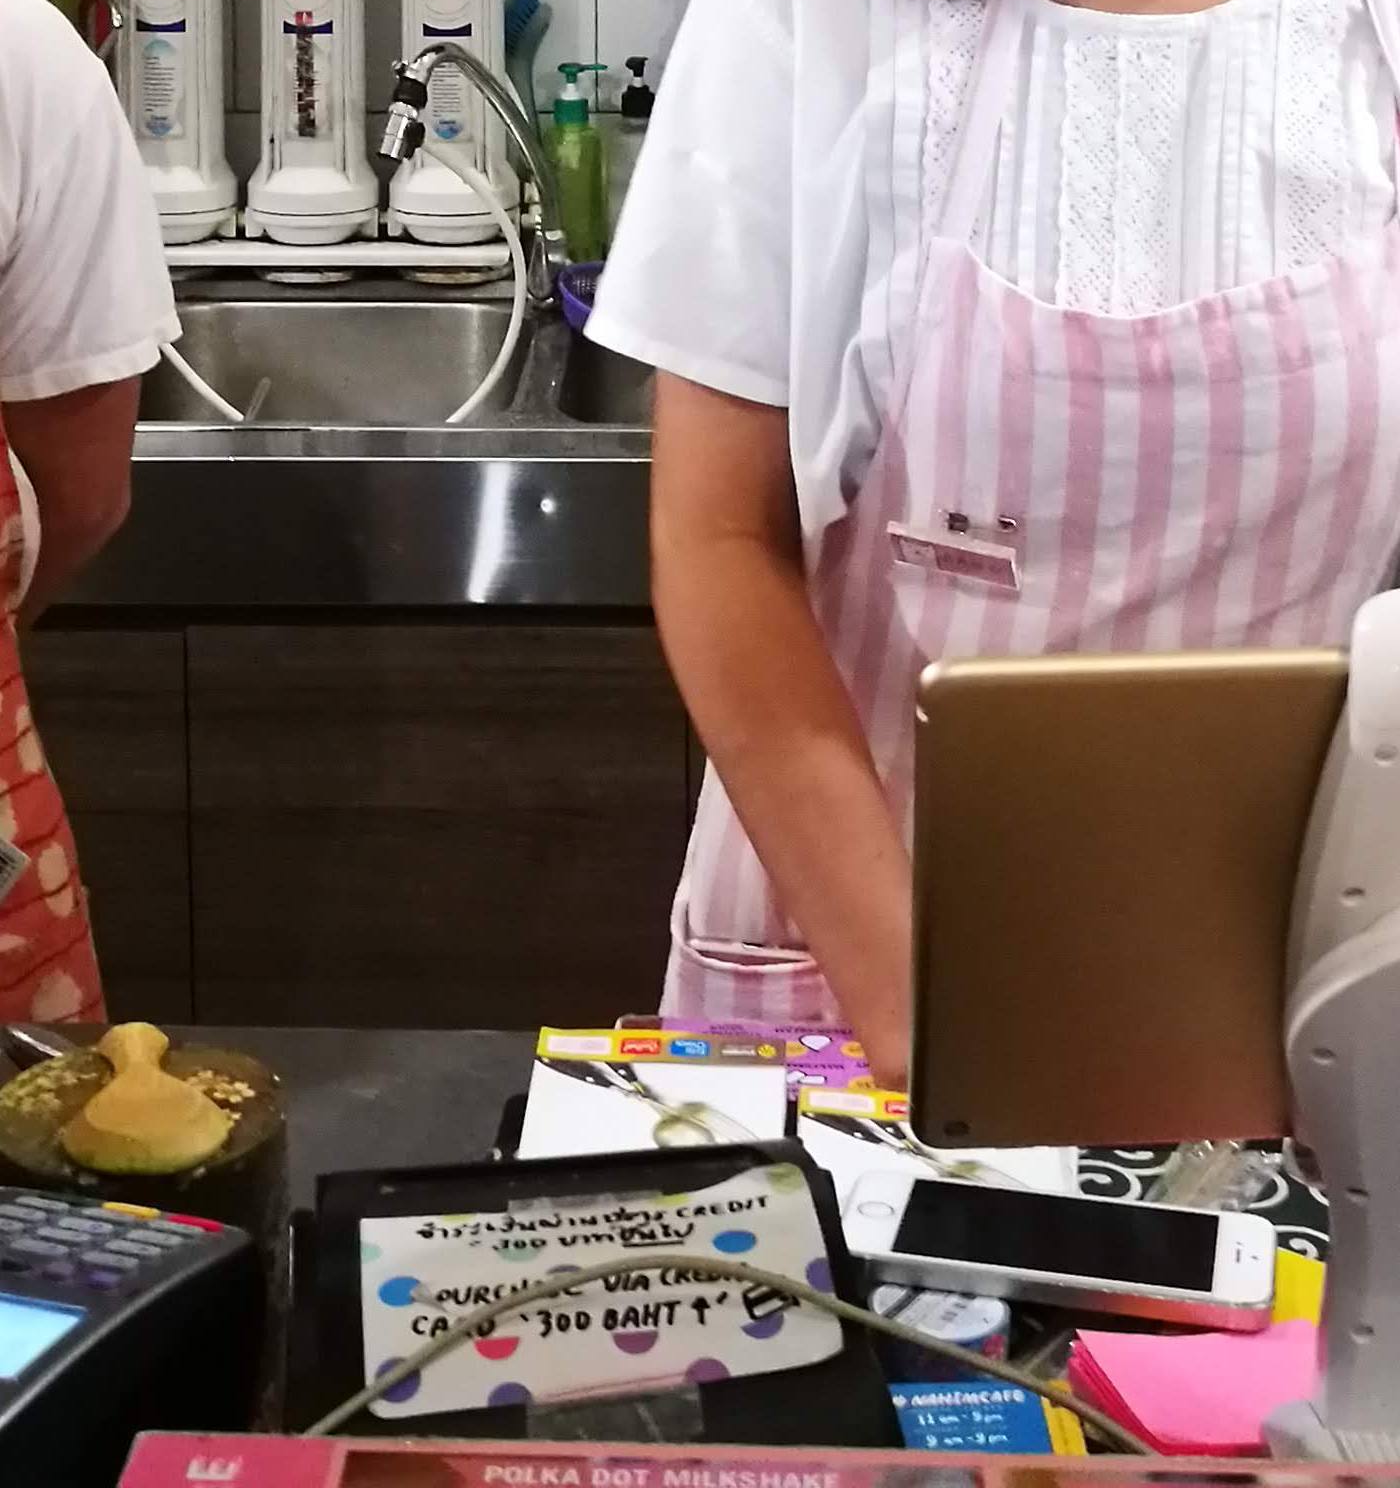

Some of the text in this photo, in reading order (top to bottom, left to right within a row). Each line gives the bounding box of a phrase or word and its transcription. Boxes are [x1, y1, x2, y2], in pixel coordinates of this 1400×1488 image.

[675, 1195, 769, 1218] CREDIT
[602, 1272, 651, 1294] VIA
[412, 1315, 496, 1339] CAD
[602, 1300, 682, 1331] BAHT
[484, 1465, 840, 1488] POLKA DOT MILKSHAKE
